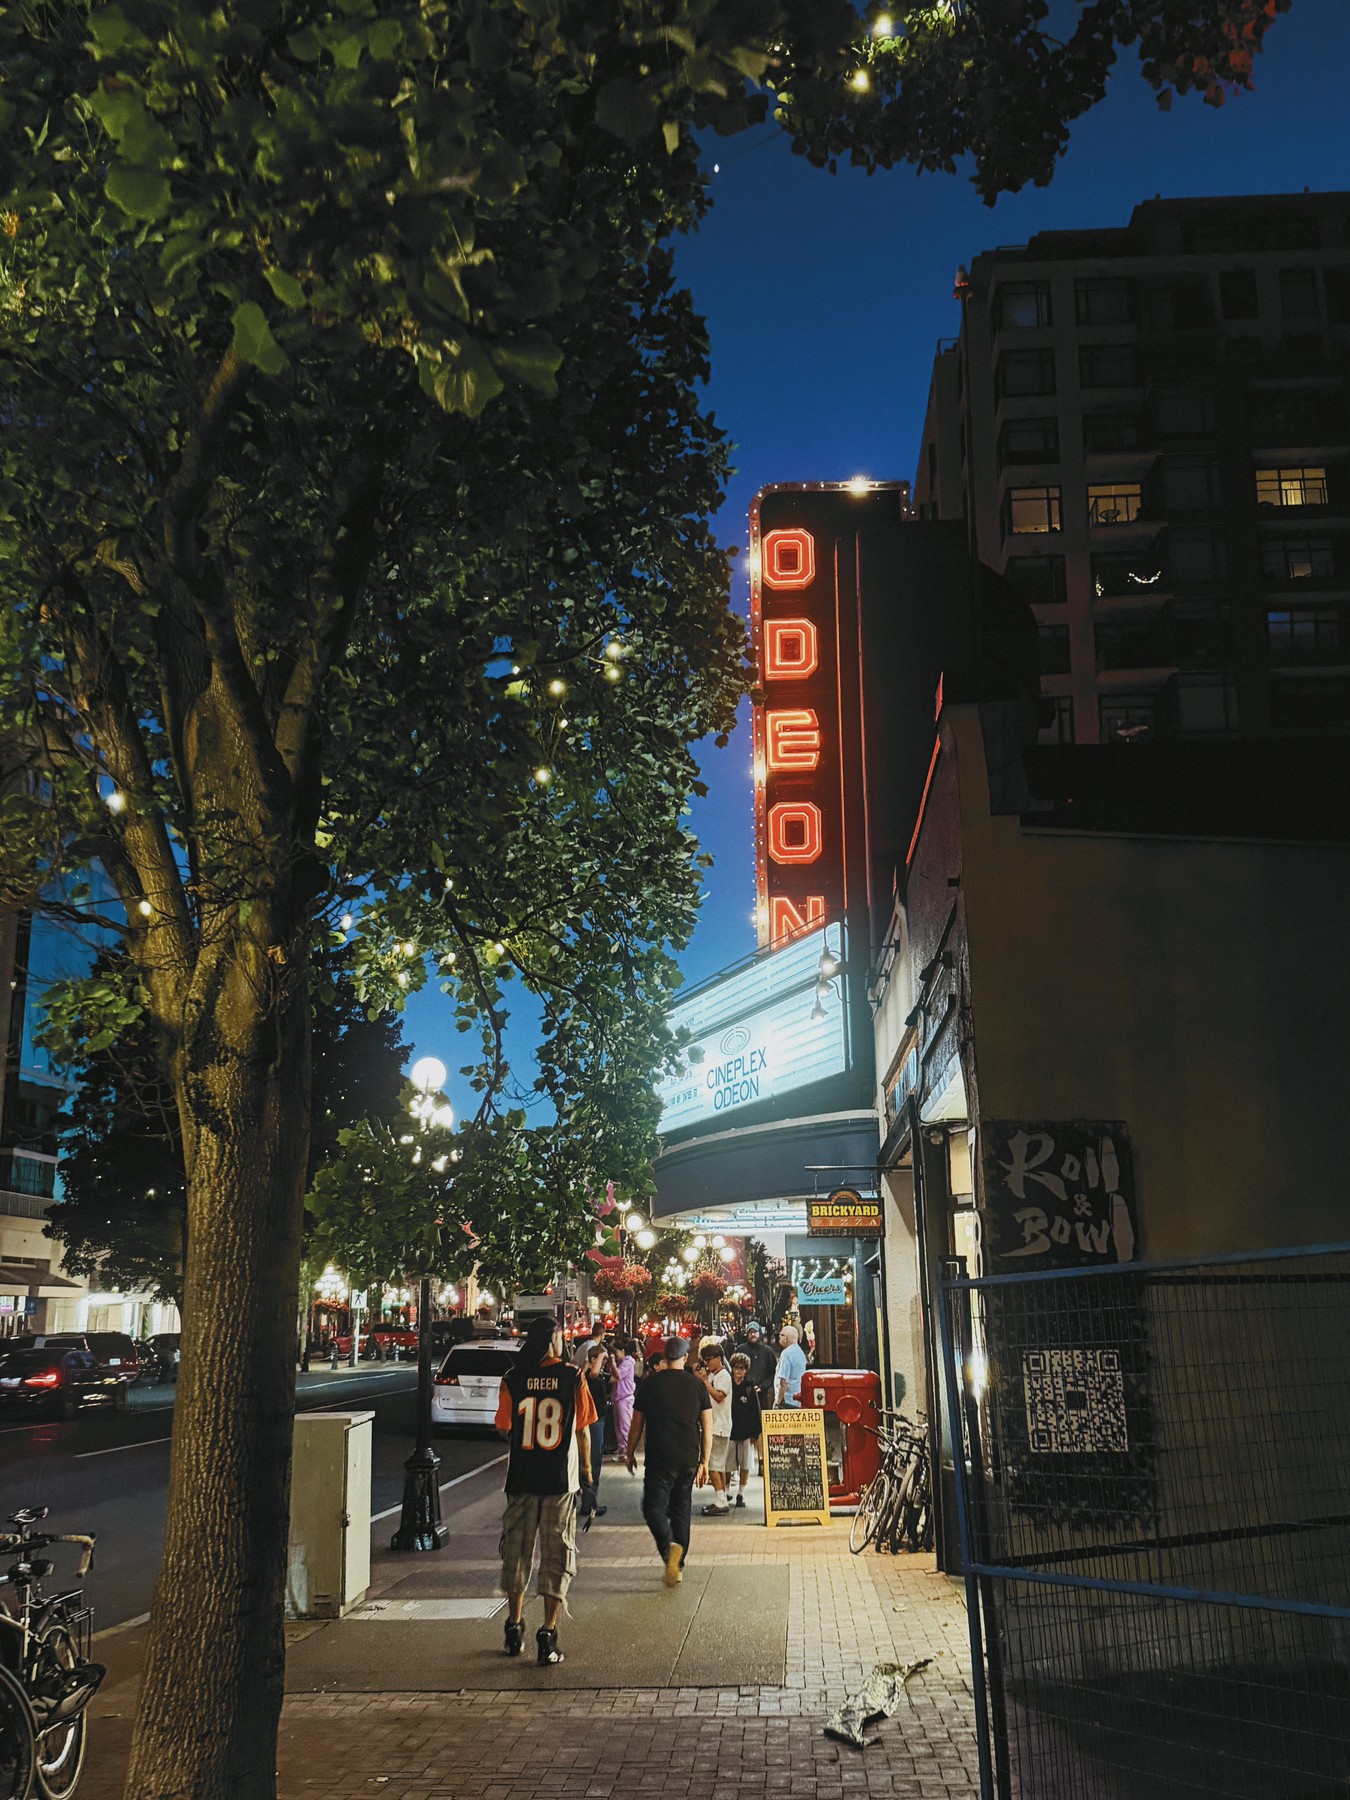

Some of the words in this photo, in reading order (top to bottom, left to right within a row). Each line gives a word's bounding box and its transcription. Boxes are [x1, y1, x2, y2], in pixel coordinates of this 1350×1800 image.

[762, 528, 825, 949] ODEON
[706, 1046, 768, 1089] CINEPLEX
[713, 1076, 759, 1110] ODEON
[998, 1129, 1120, 1200] Roll
[811, 1205, 879, 1216] BRICKYARD
[1073, 1193, 1093, 1217] &
[815, 1218, 878, 1226] PIZZA
[1000, 1193, 1134, 1263] Bowl
[800, 1281, 843, 1296] Cheers
[527, 1377, 559, 1390] GREEN
[518, 1396, 563, 1451] 18
[765, 1412, 821, 1422] BRICKYARD
